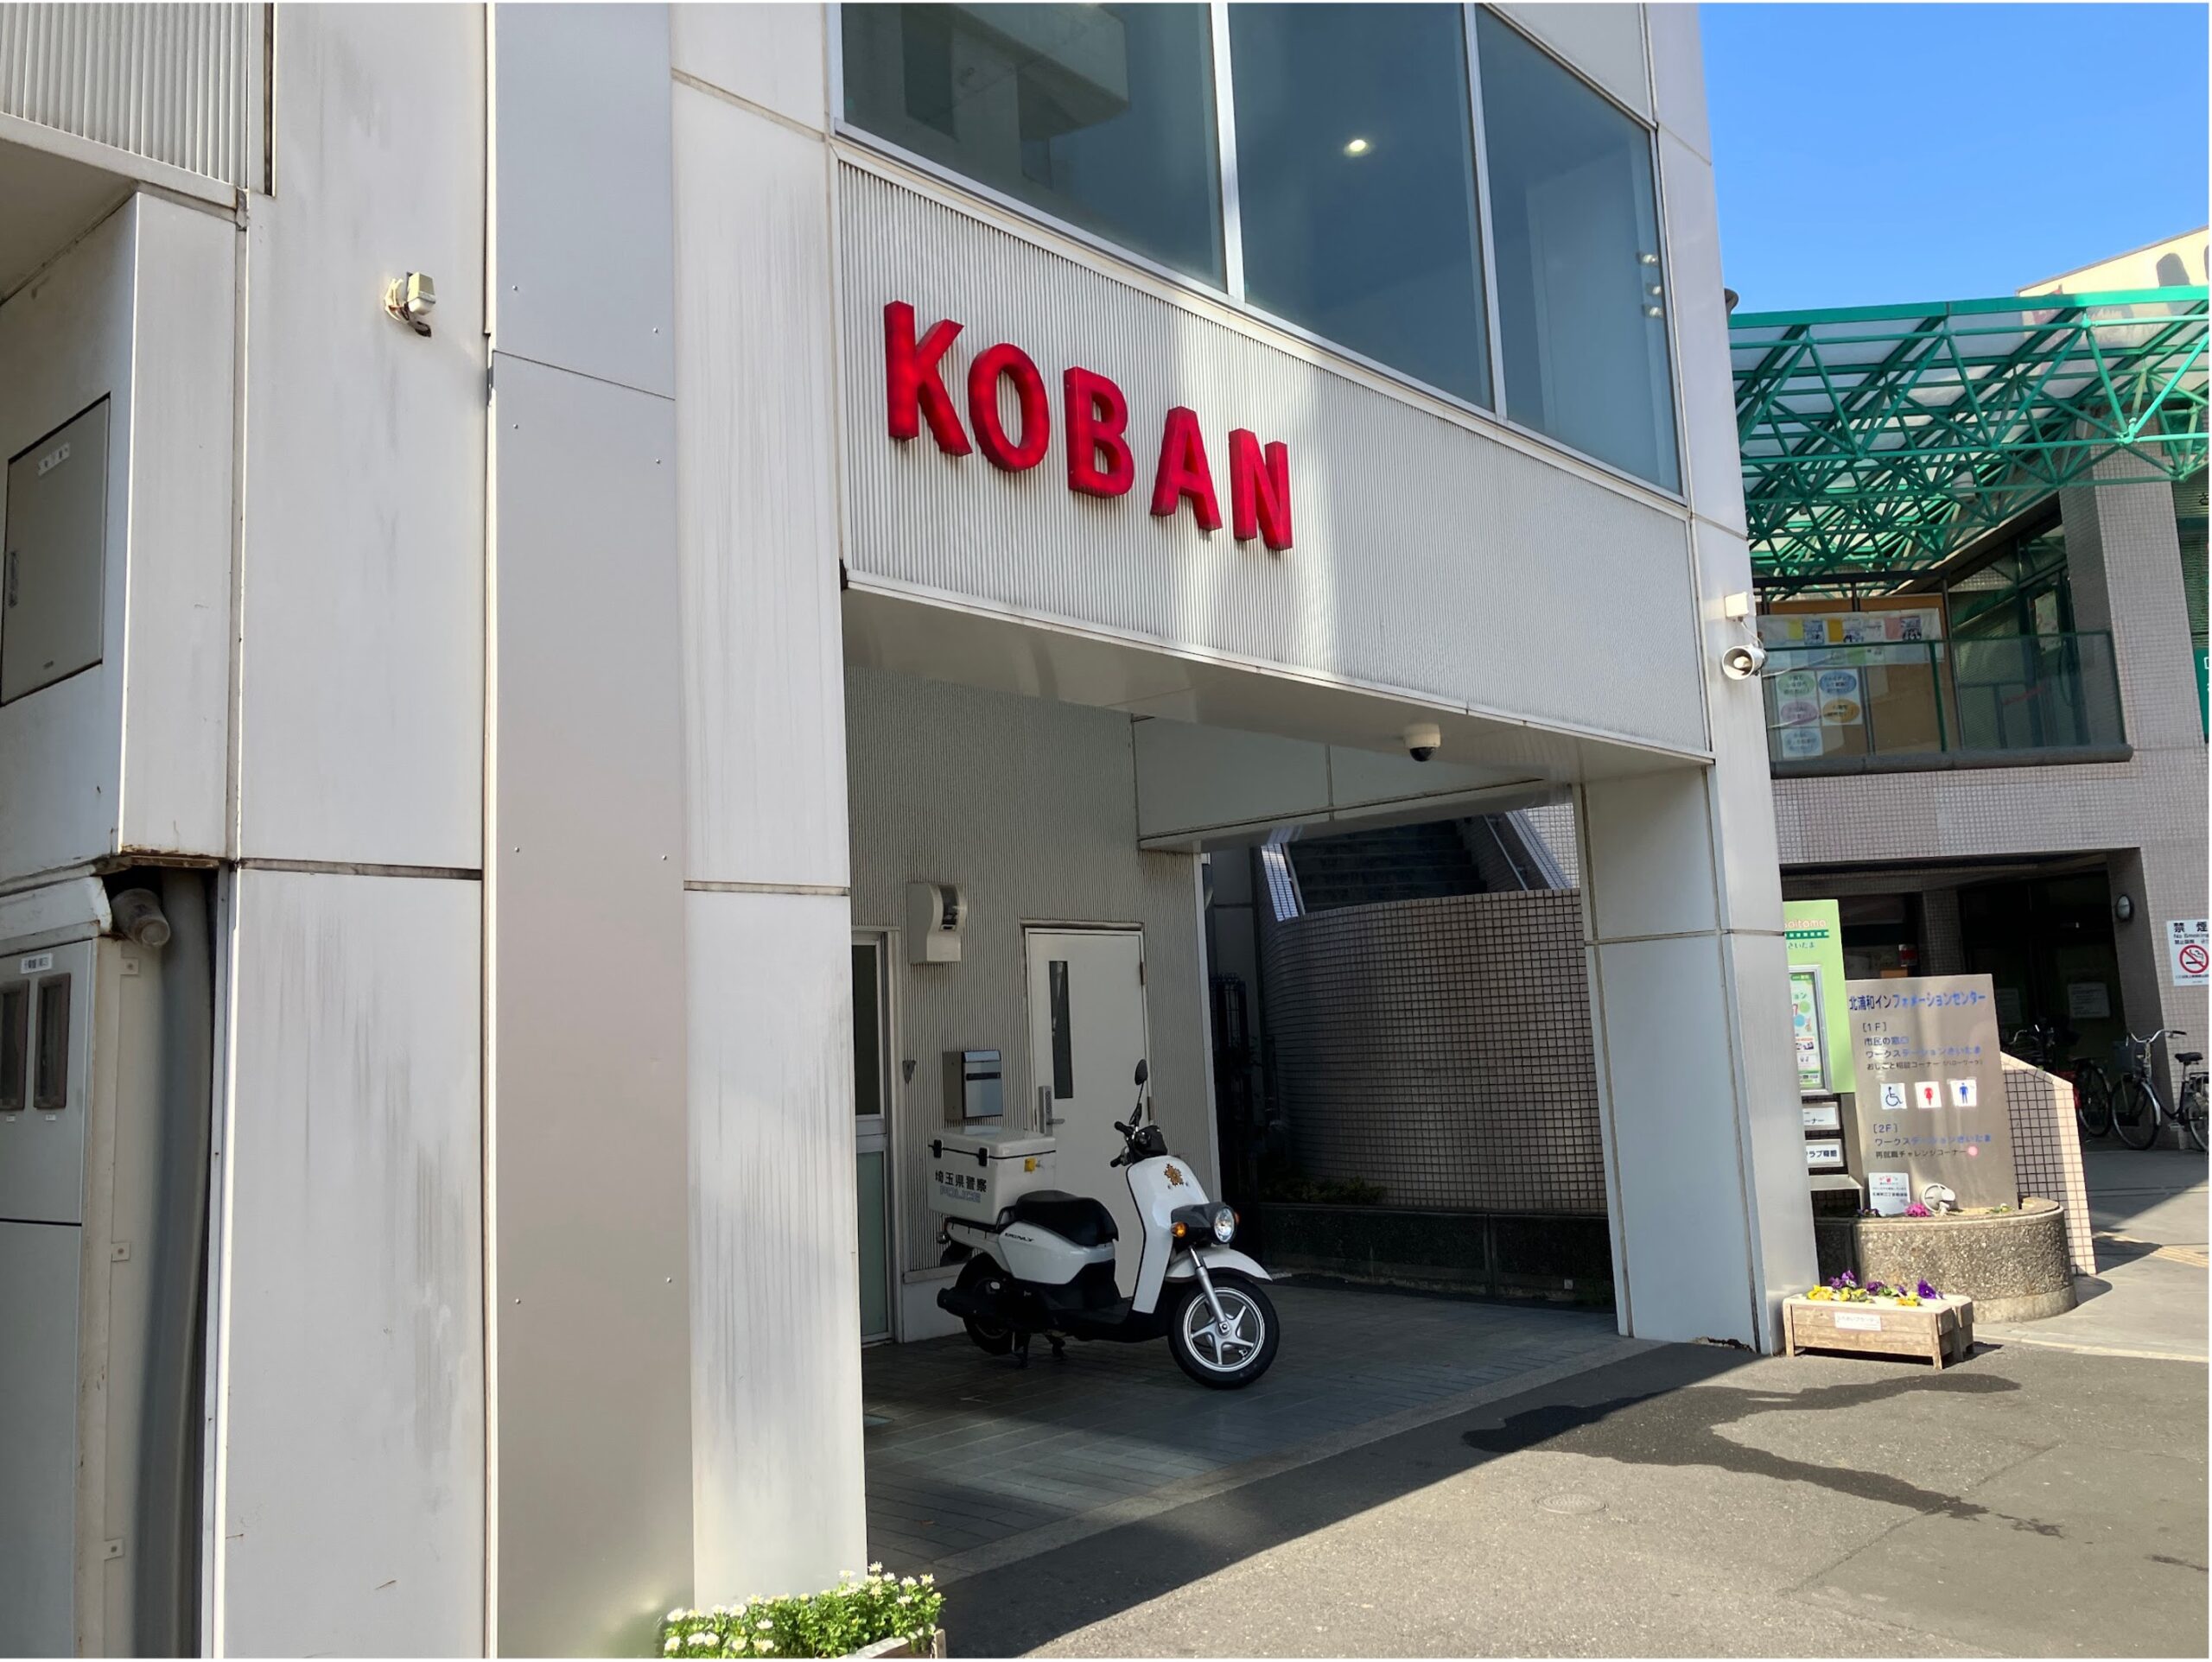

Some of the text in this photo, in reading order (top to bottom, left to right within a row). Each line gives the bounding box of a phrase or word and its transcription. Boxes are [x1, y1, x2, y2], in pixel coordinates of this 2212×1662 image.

[884, 301, 1293, 551] KOBAN
[2173, 922, 2209, 933] 禁煙
[1849, 990, 1986, 1012] 北浦和インフォメーションセンター
[1866, 1045, 1982, 1059] ワークステーションさいたま
[1874, 1133, 1992, 1147] ワークステーションさいたま
[935, 1169, 987, 1193] 埼玉県警察
[939, 1184, 982, 1203] POLICE
